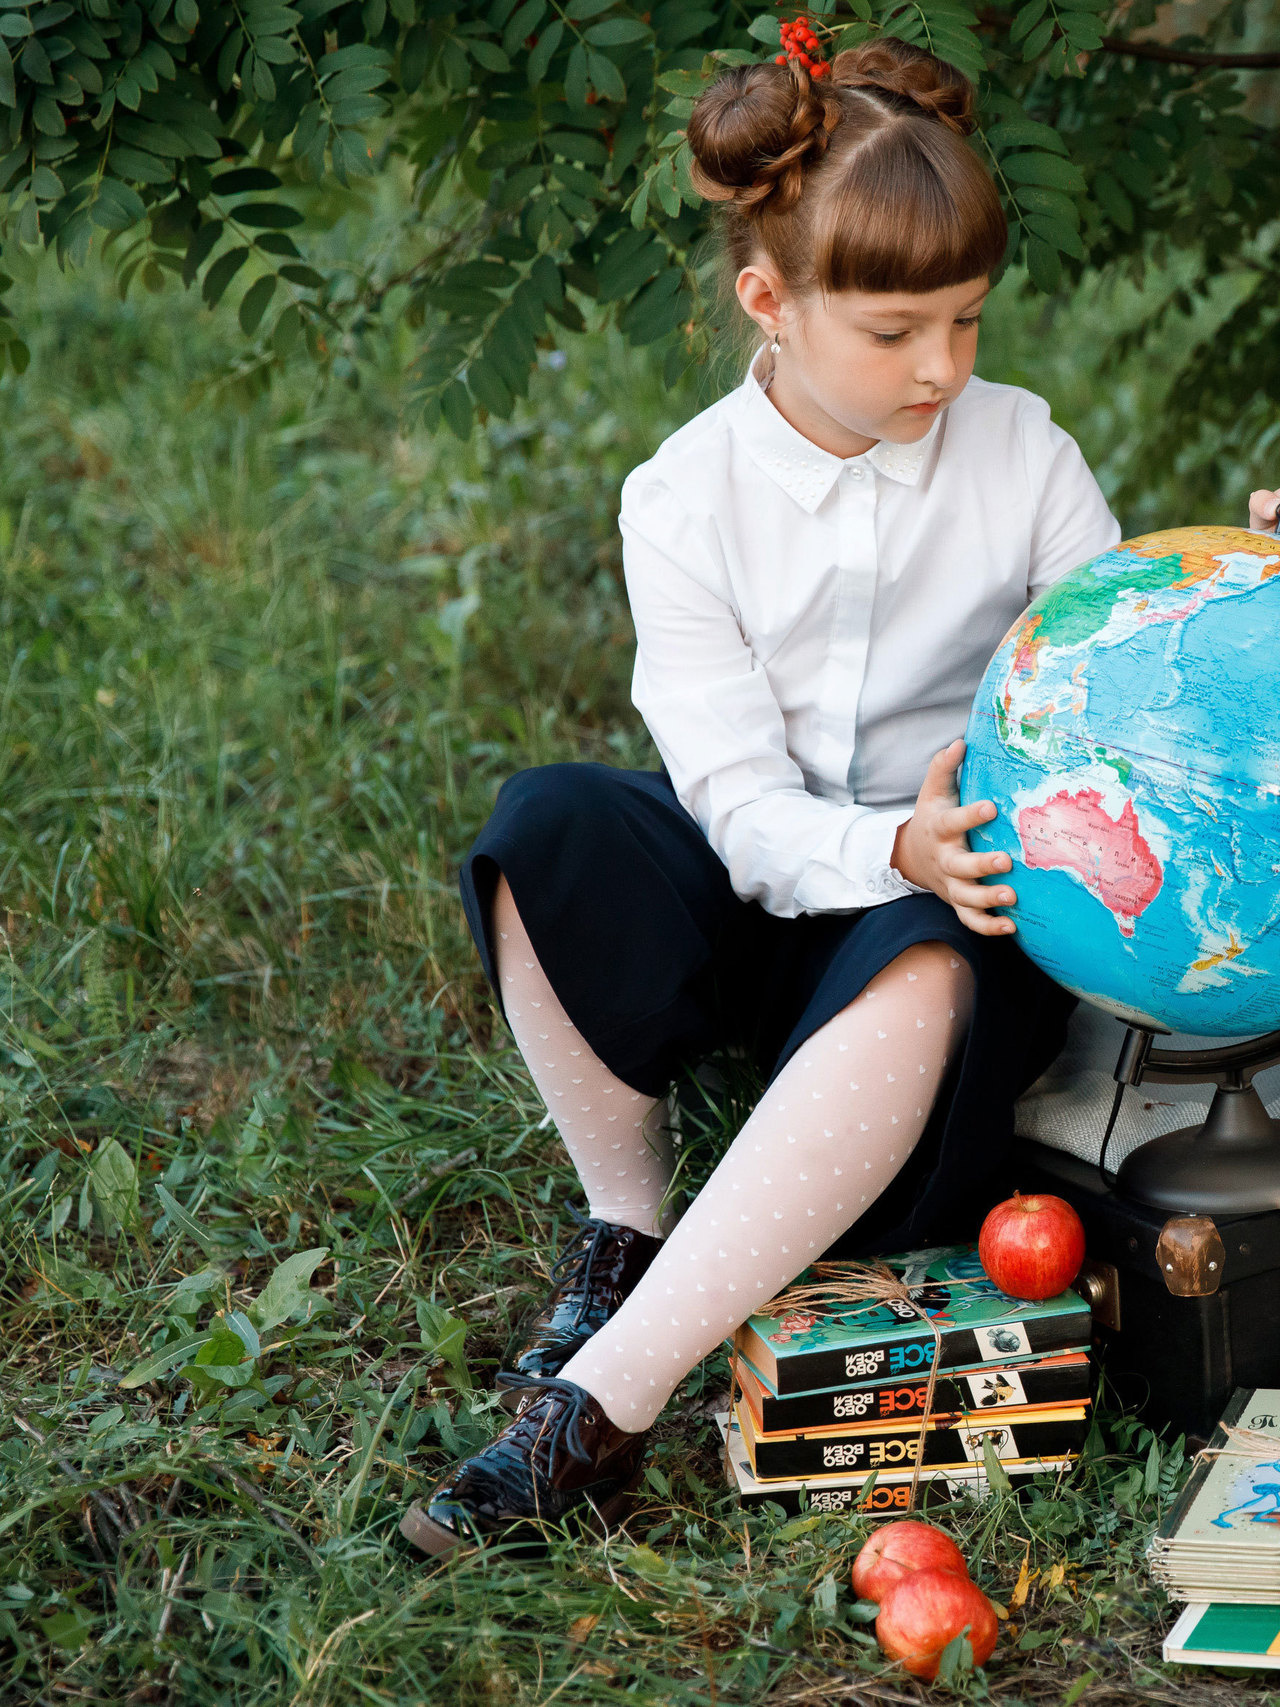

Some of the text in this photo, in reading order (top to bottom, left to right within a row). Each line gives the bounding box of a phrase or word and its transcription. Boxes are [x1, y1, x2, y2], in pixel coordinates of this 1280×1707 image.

[845, 1349, 885, 1367] ВСЕМ
[845, 1361, 878, 1378] ОБО
[833, 1392, 874, 1408] ВСЕМ
[833, 1404, 868, 1418] ОБО
[823, 1443, 864, 1457] ВСЕМ
[823, 1454, 858, 1468] ОБО
